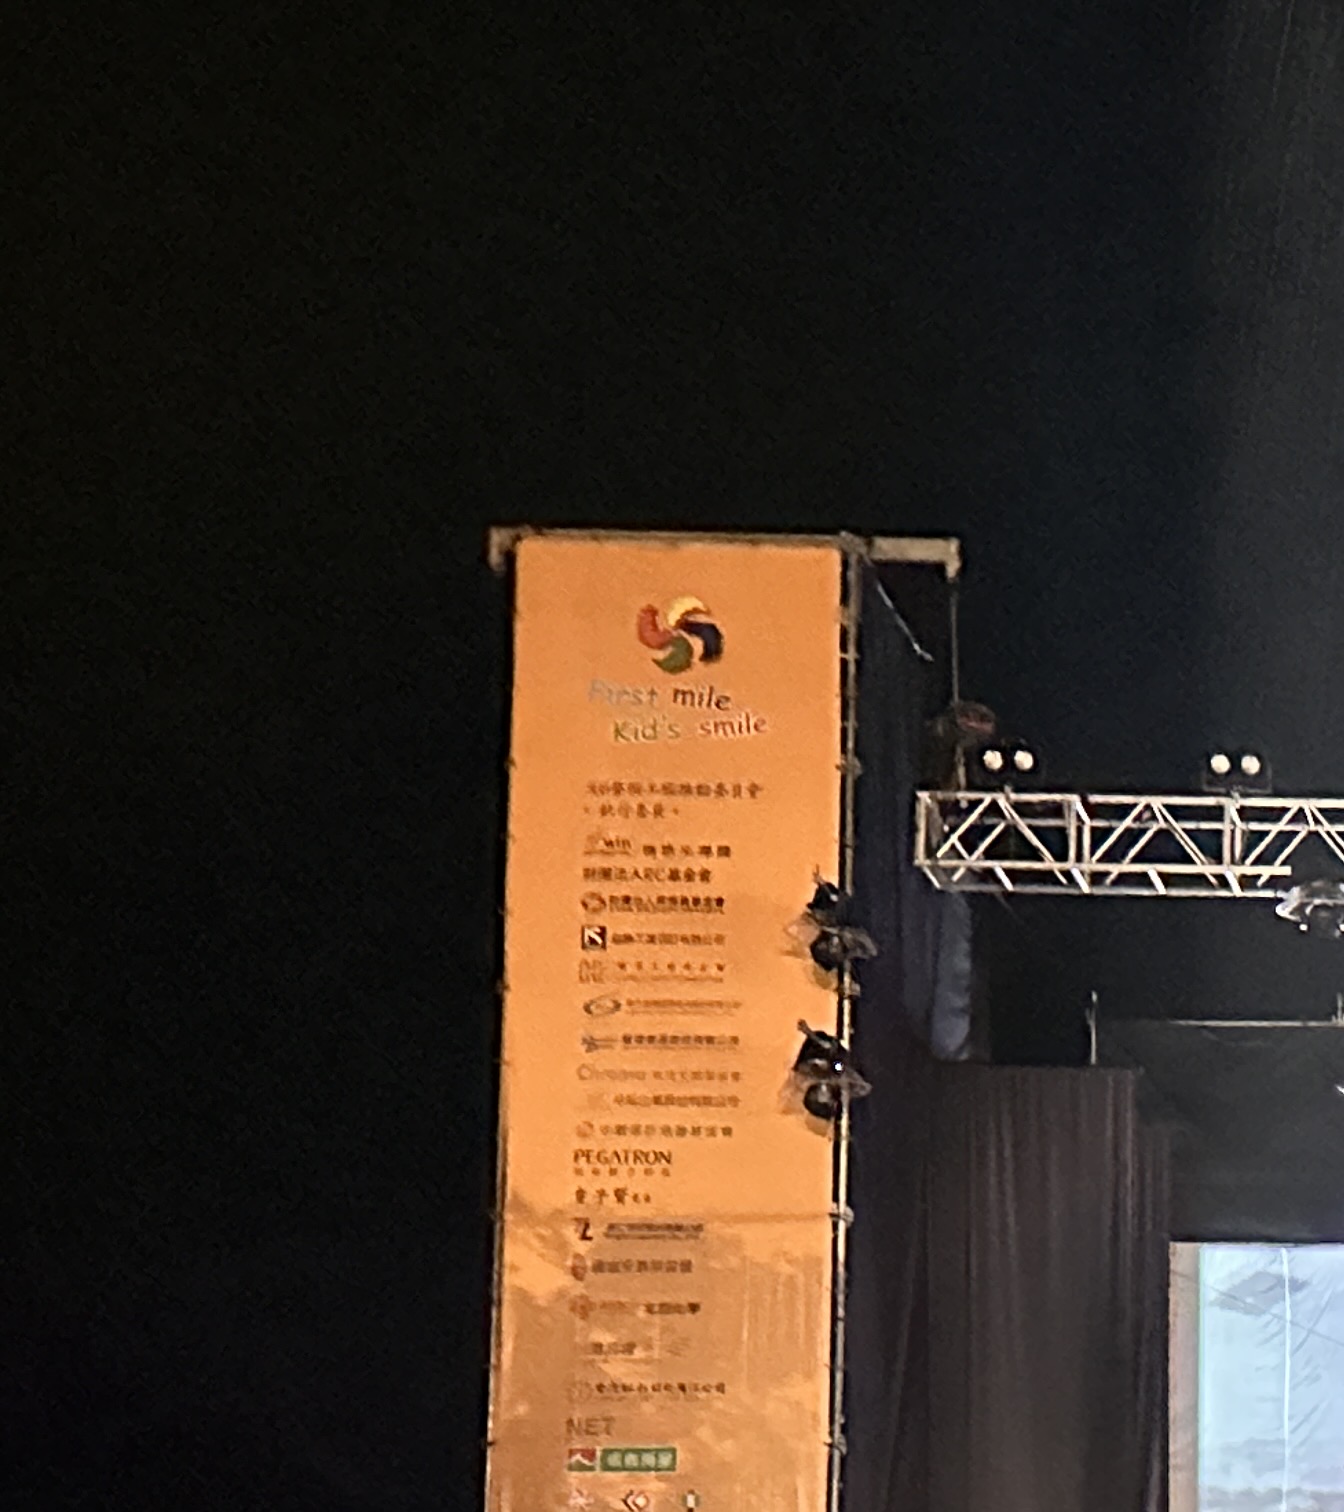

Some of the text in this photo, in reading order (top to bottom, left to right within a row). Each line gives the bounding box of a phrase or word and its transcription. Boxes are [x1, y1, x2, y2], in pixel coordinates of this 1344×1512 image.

[672, 685, 731, 711] mile
[613, 712, 767, 742] Kid's smile
[573, 1149, 673, 1165] PEGATRON
[566, 1416, 616, 1436] NET
